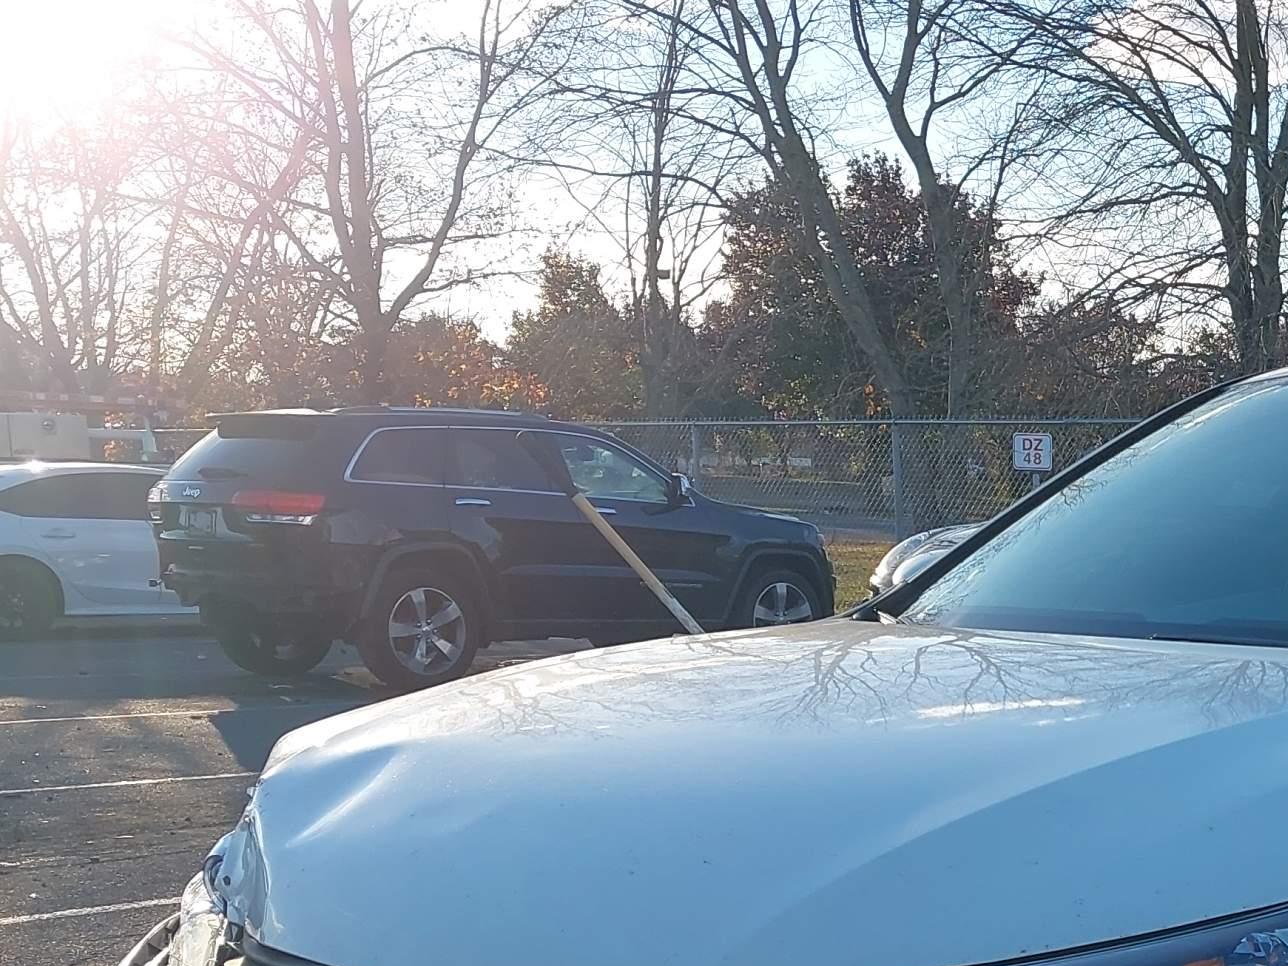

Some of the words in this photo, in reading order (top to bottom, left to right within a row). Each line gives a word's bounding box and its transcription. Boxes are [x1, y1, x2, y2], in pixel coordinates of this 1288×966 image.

[1022, 438, 1043, 451] DZ
[1023, 452, 1042, 465] 48
[182, 486, 201, 498] Jeep
